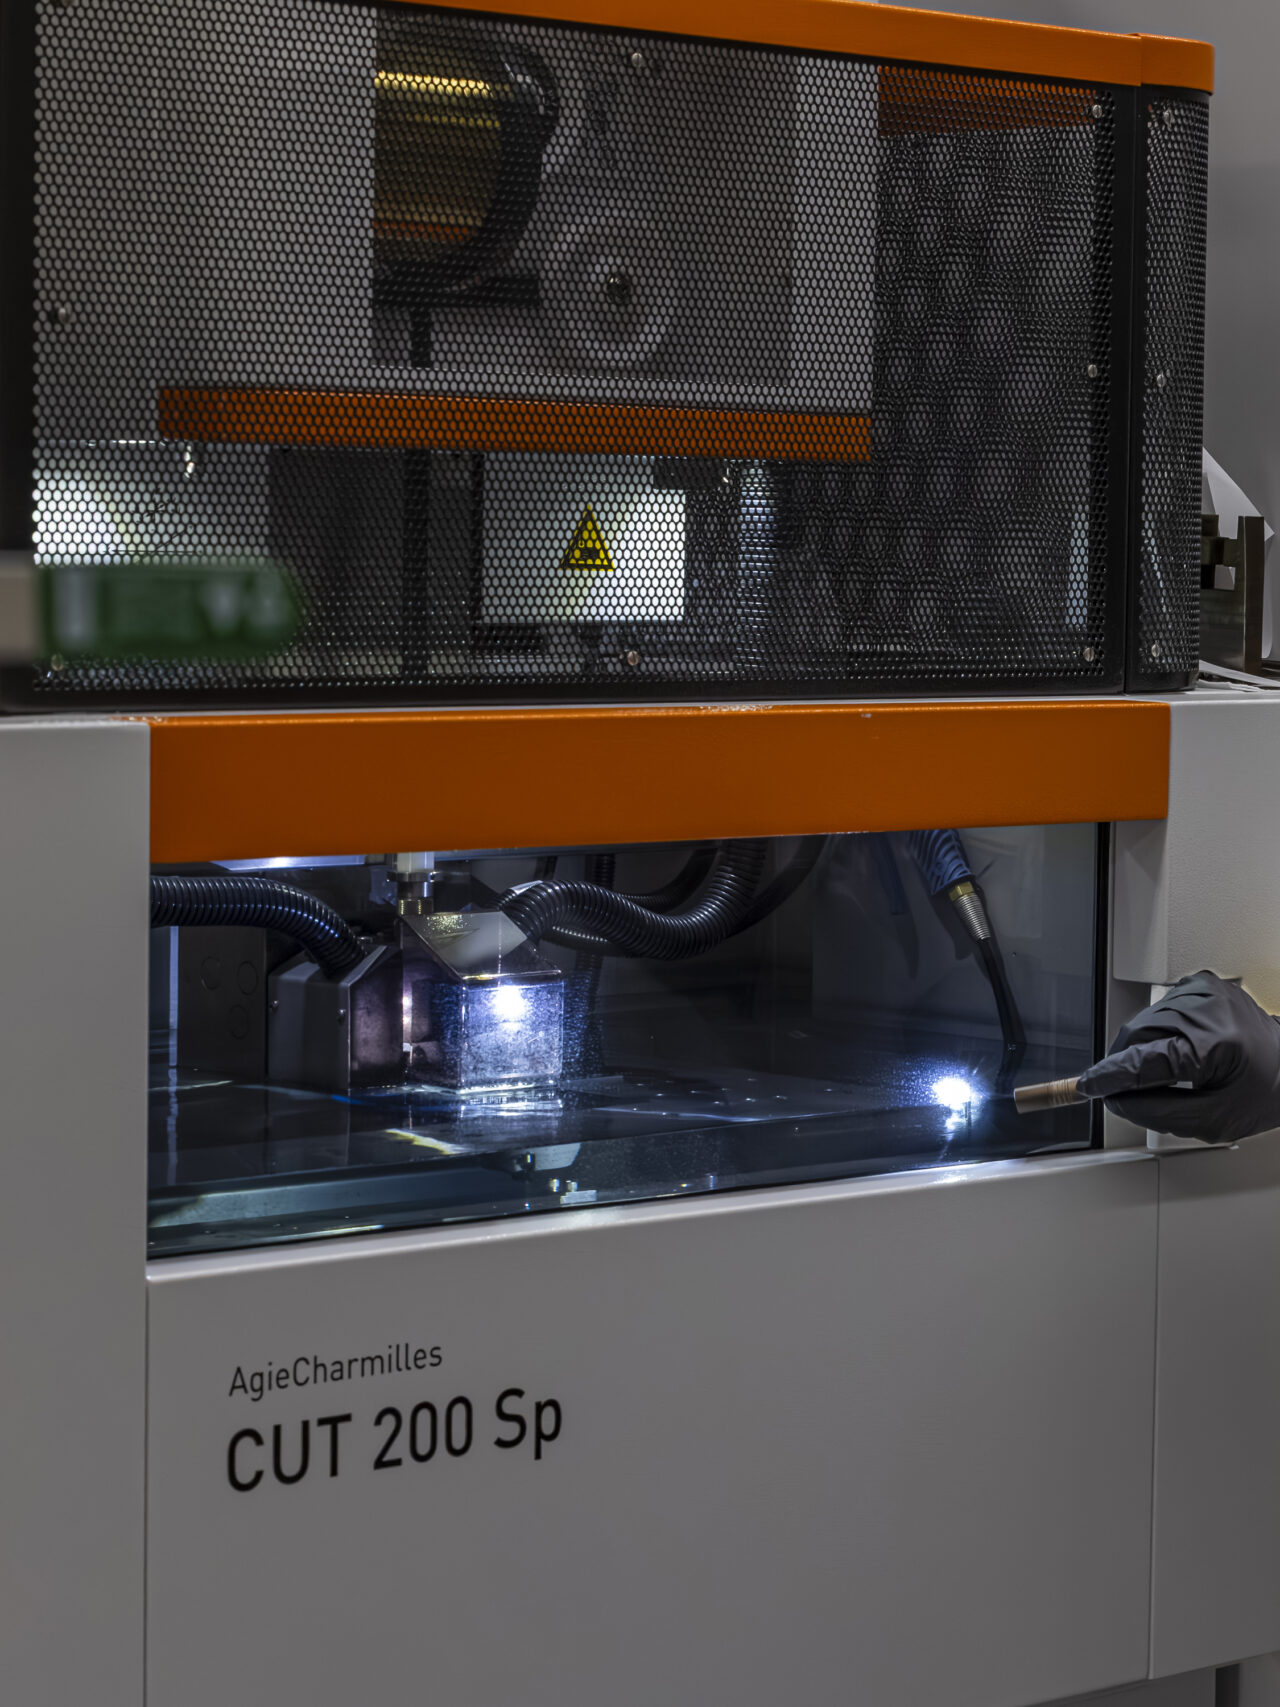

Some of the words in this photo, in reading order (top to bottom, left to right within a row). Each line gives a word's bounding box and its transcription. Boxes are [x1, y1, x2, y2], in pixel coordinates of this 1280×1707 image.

[228, 1342, 443, 1402] AgieCharmilles
[226, 1412, 353, 1492] CUT
[373, 1395, 474, 1470] 200
[493, 1387, 562, 1460] Sp
